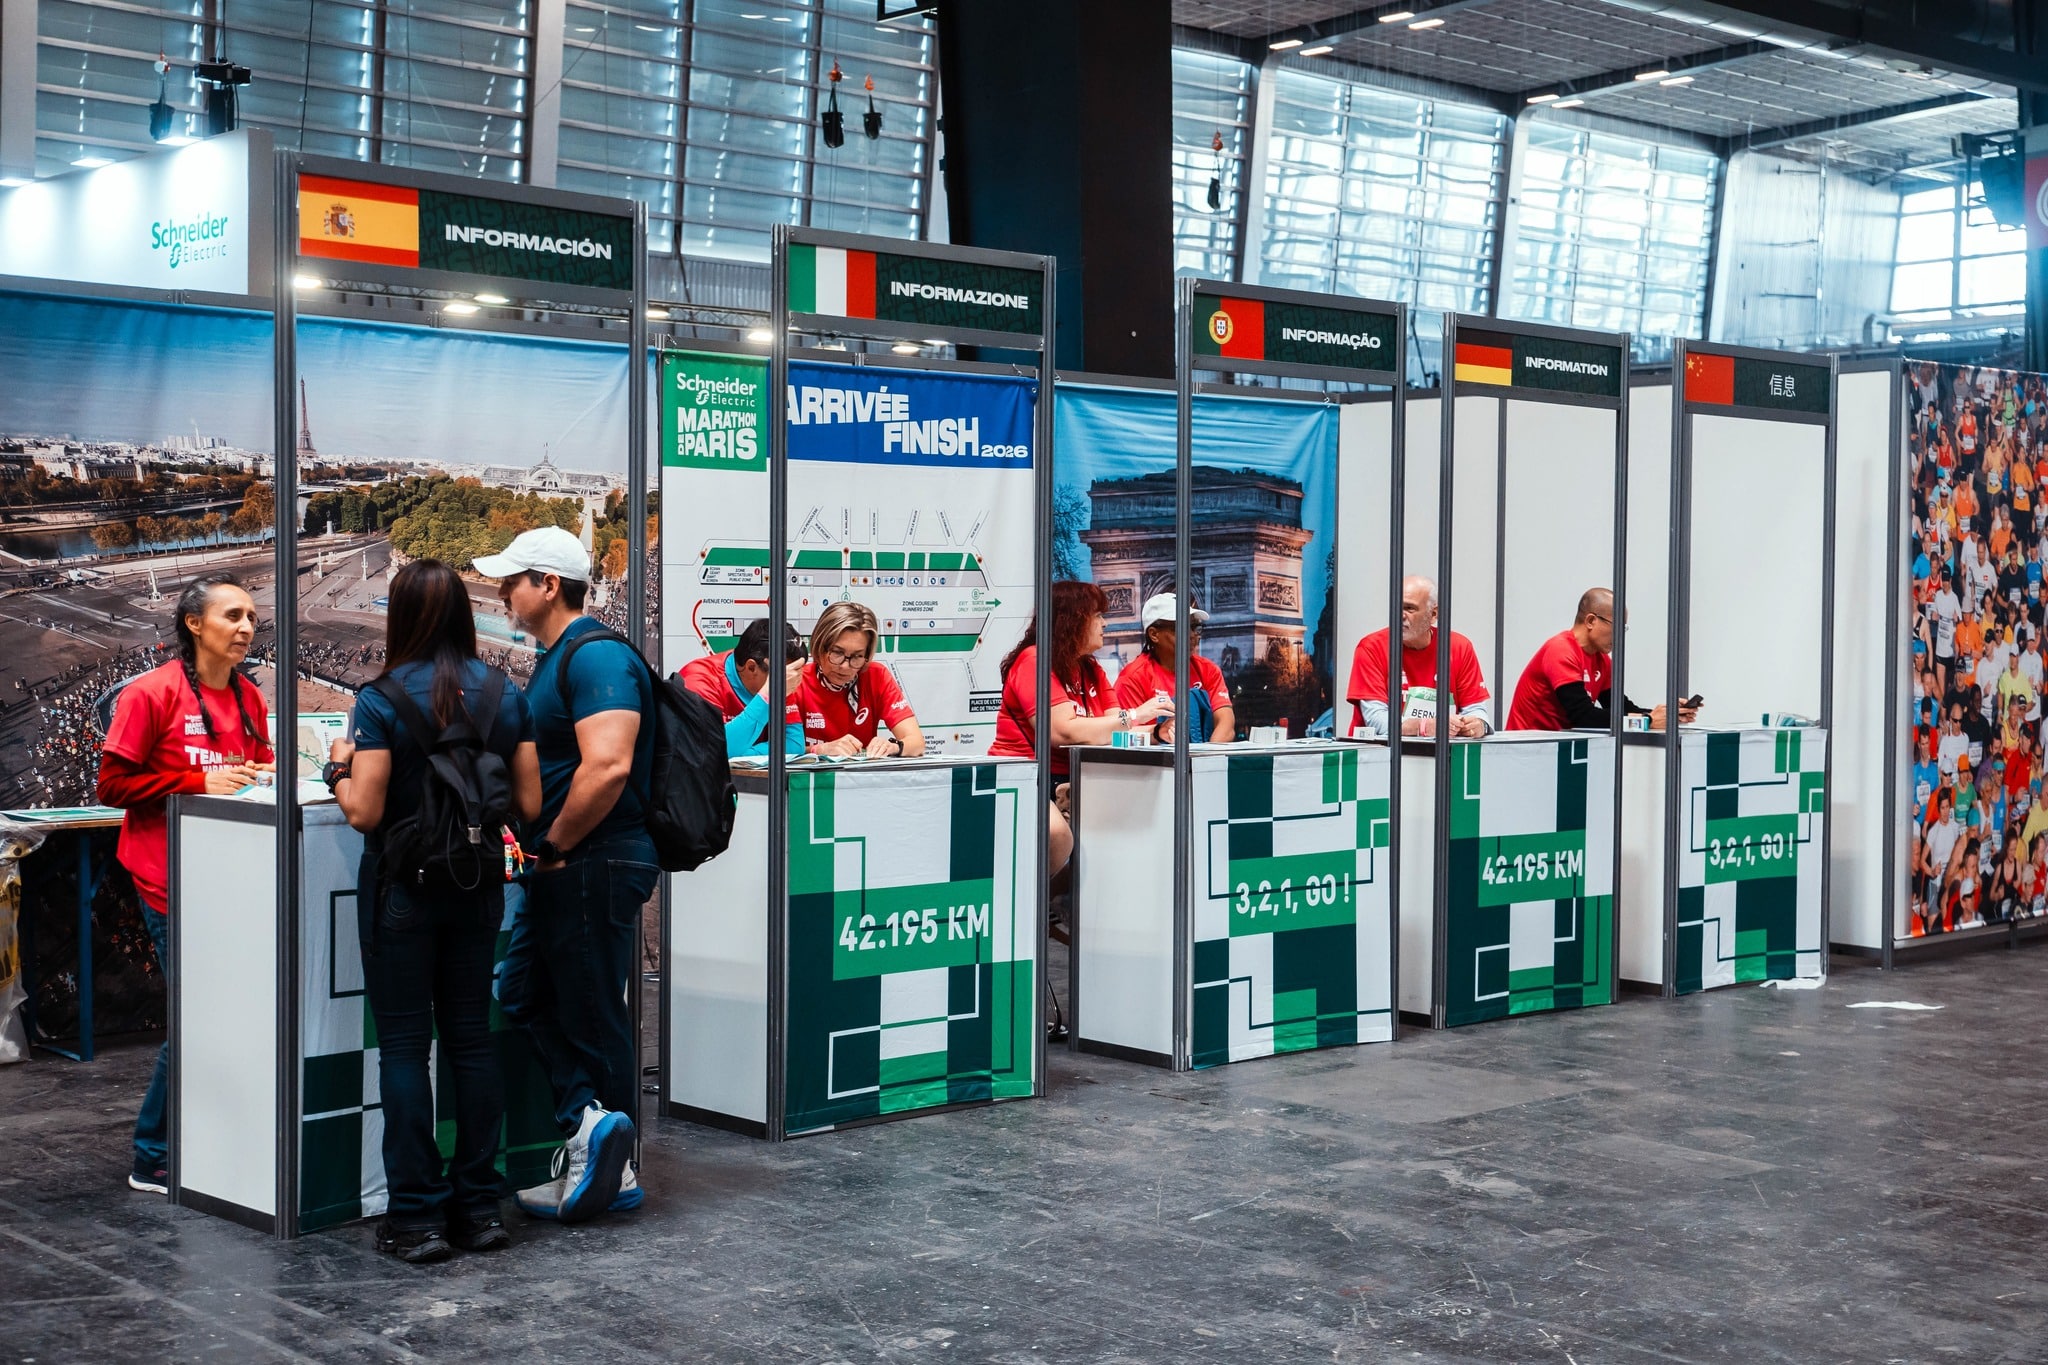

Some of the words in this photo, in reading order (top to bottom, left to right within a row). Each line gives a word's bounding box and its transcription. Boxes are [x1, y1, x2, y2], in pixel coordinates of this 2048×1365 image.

[152, 212, 228, 249] Schneider
[446, 224, 612, 260] INFORMACIÓN
[184, 245, 226, 262] Electric
[891, 281, 1028, 310] INFORMAZIONE
[1282, 328, 1381, 350] INFORMAÇÃO
[1526, 356, 1608, 376] INFORMATION
[676, 372, 757, 396] Schneider
[1769, 374, 1796, 398] 信息
[712, 394, 756, 407] Electric
[787, 385, 910, 425] ARRIVÉE
[678, 406, 756, 432] MARATHON
[678, 434, 684, 456] DE
[684, 428, 758, 460] PARIS
[884, 416, 979, 456] FINISH
[981, 444, 1028, 458] 2026
[1412, 708, 1435, 718] BERN
[184, 745, 223, 766] TEAM
[1710, 835, 1756, 869] 3,2,1,
[1760, 832, 1784, 860] GO
[1788, 832, 1793, 858] !
[1482, 852, 1548, 885] 42.195
[1554, 849, 1583, 879] KM
[1236, 878, 1298, 918] 3,2,1,
[1305, 873, 1336, 906] GO
[1343, 872, 1349, 903] !
[839, 908, 938, 952] 42.195
[948, 903, 989, 940] KM
